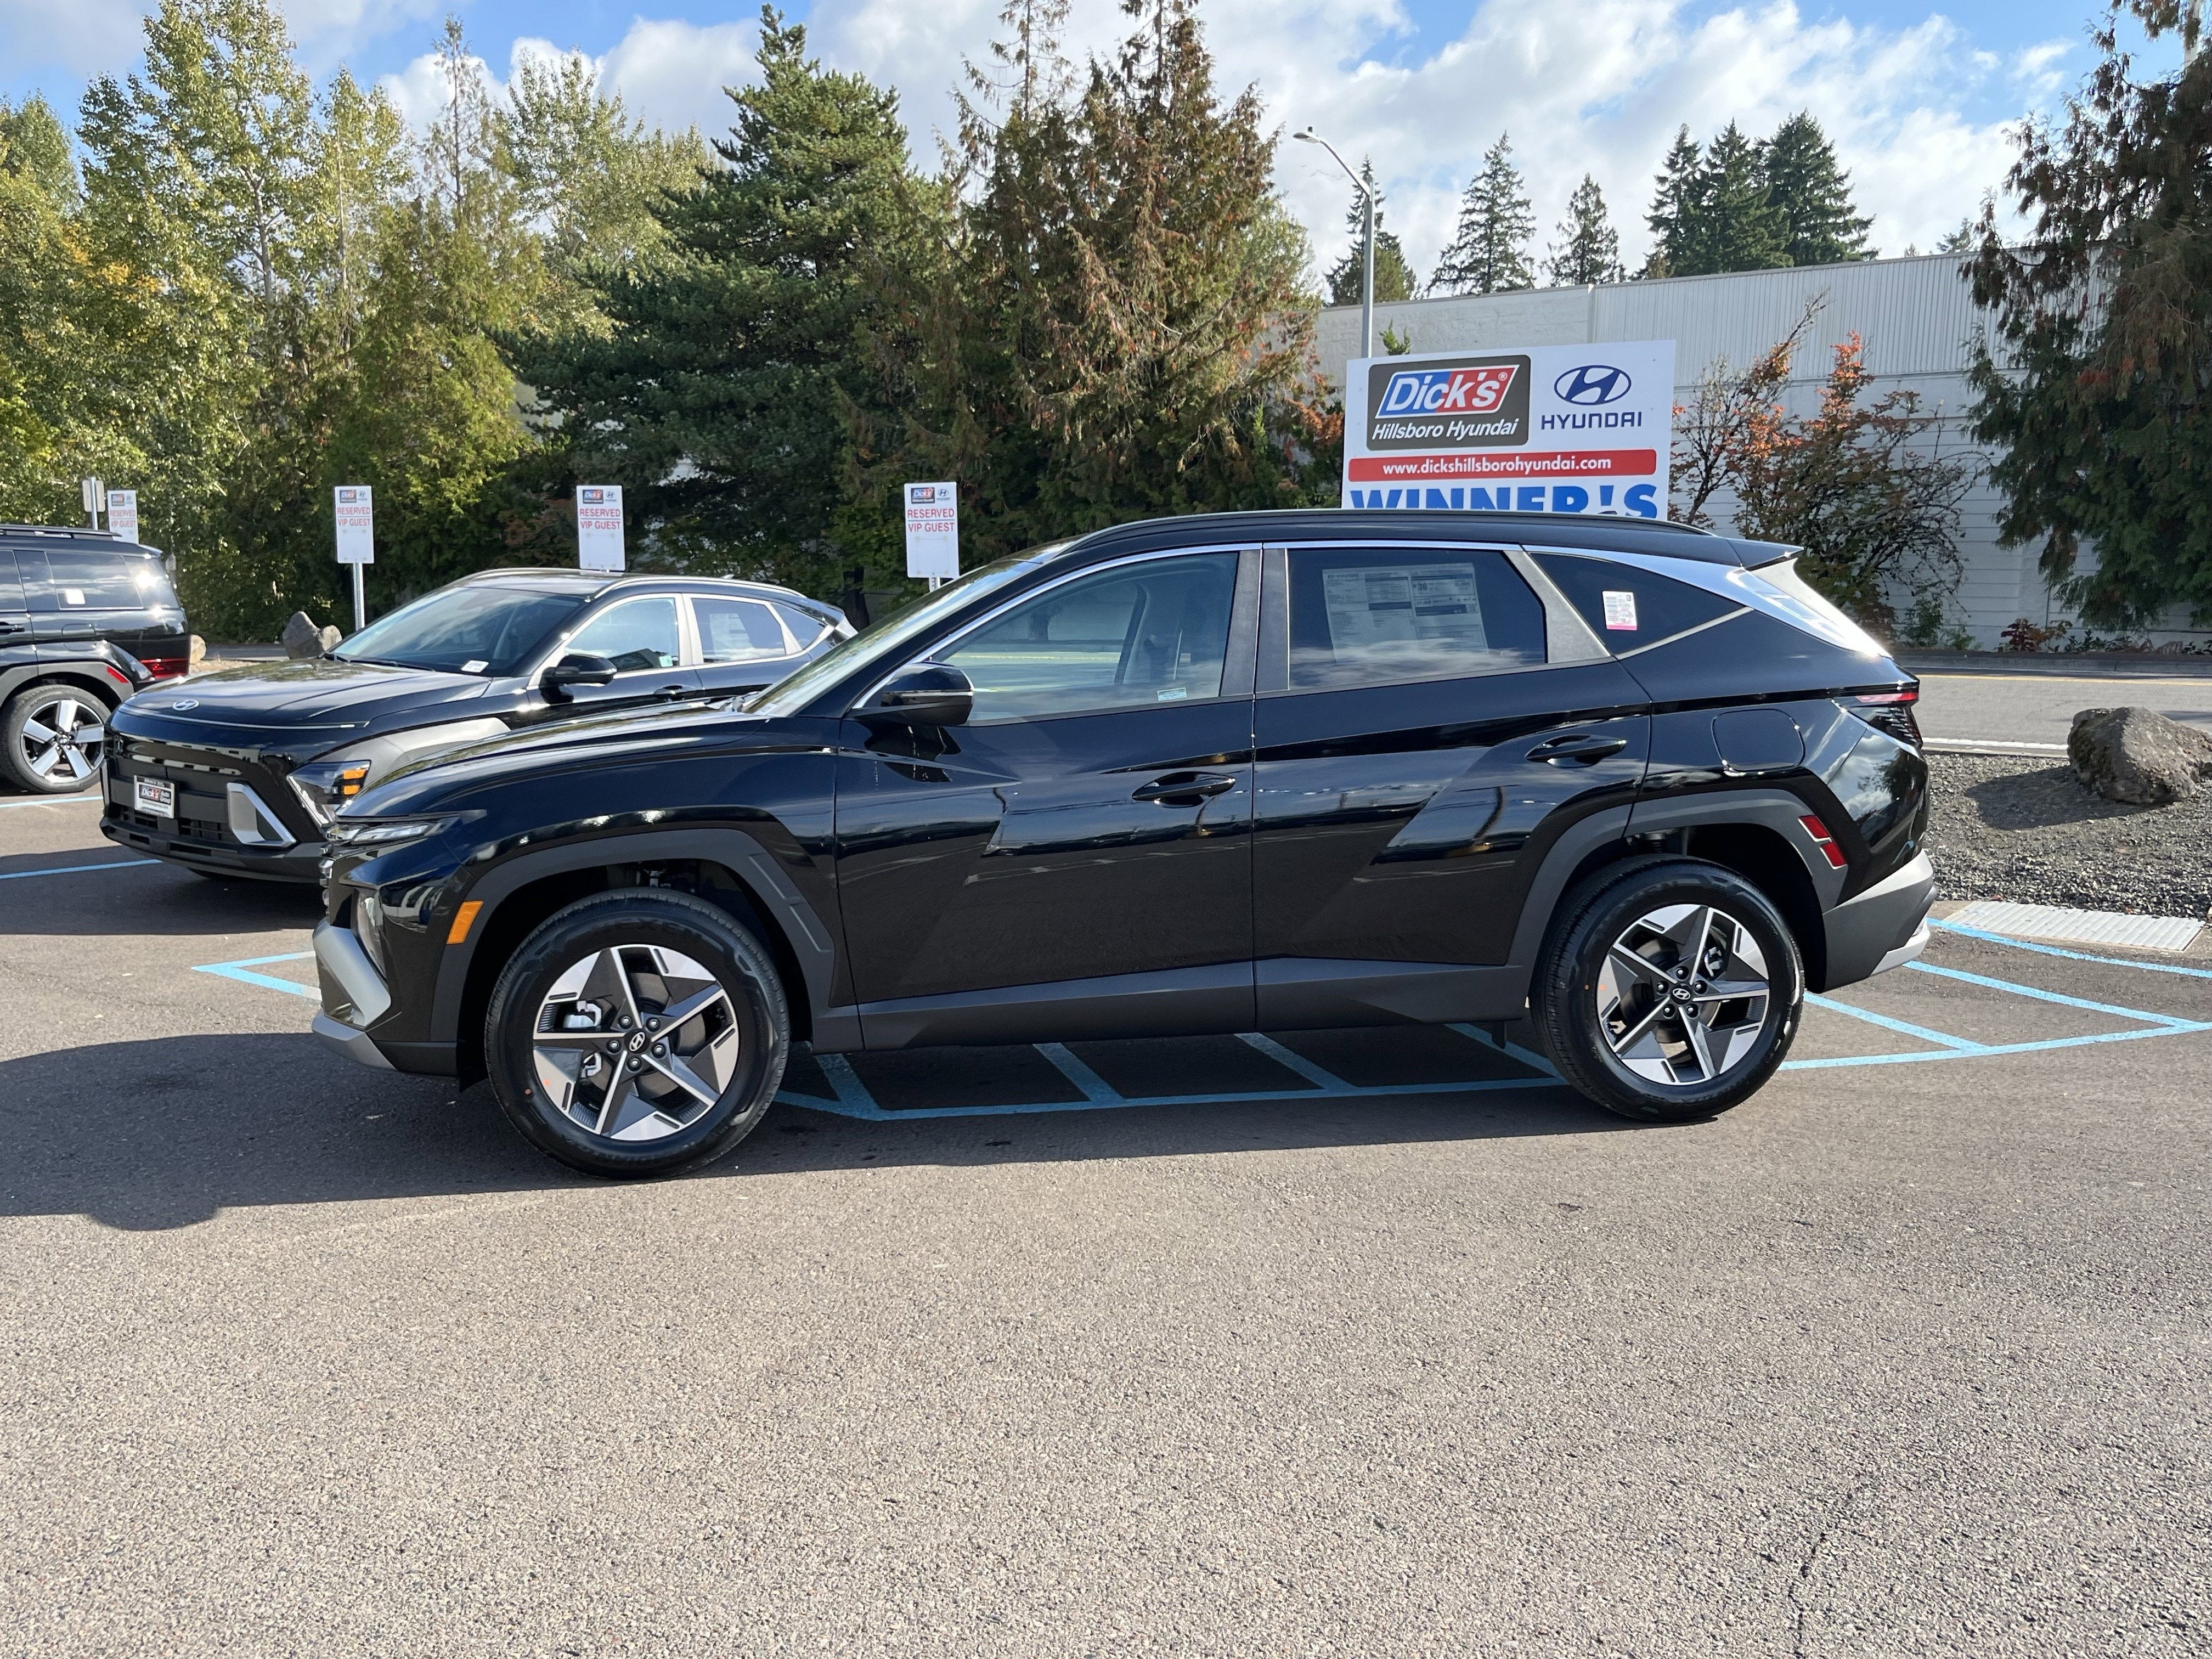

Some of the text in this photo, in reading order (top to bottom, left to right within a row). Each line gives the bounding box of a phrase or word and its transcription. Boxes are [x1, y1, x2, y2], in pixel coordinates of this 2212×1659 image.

[1386, 372, 1499, 411] Dick's
[1541, 411, 1642, 430] HYUNDAI
[1372, 418, 1520, 441] Hillsboro Hyundai
[1383, 455, 1611, 475] www.dickshillsborohyundai.com
[579, 508, 620, 517] RESERVED
[907, 508, 955, 518] RESERVED
[595, 521, 620, 529] GUEST
[908, 522, 955, 532] VIP GUEST
